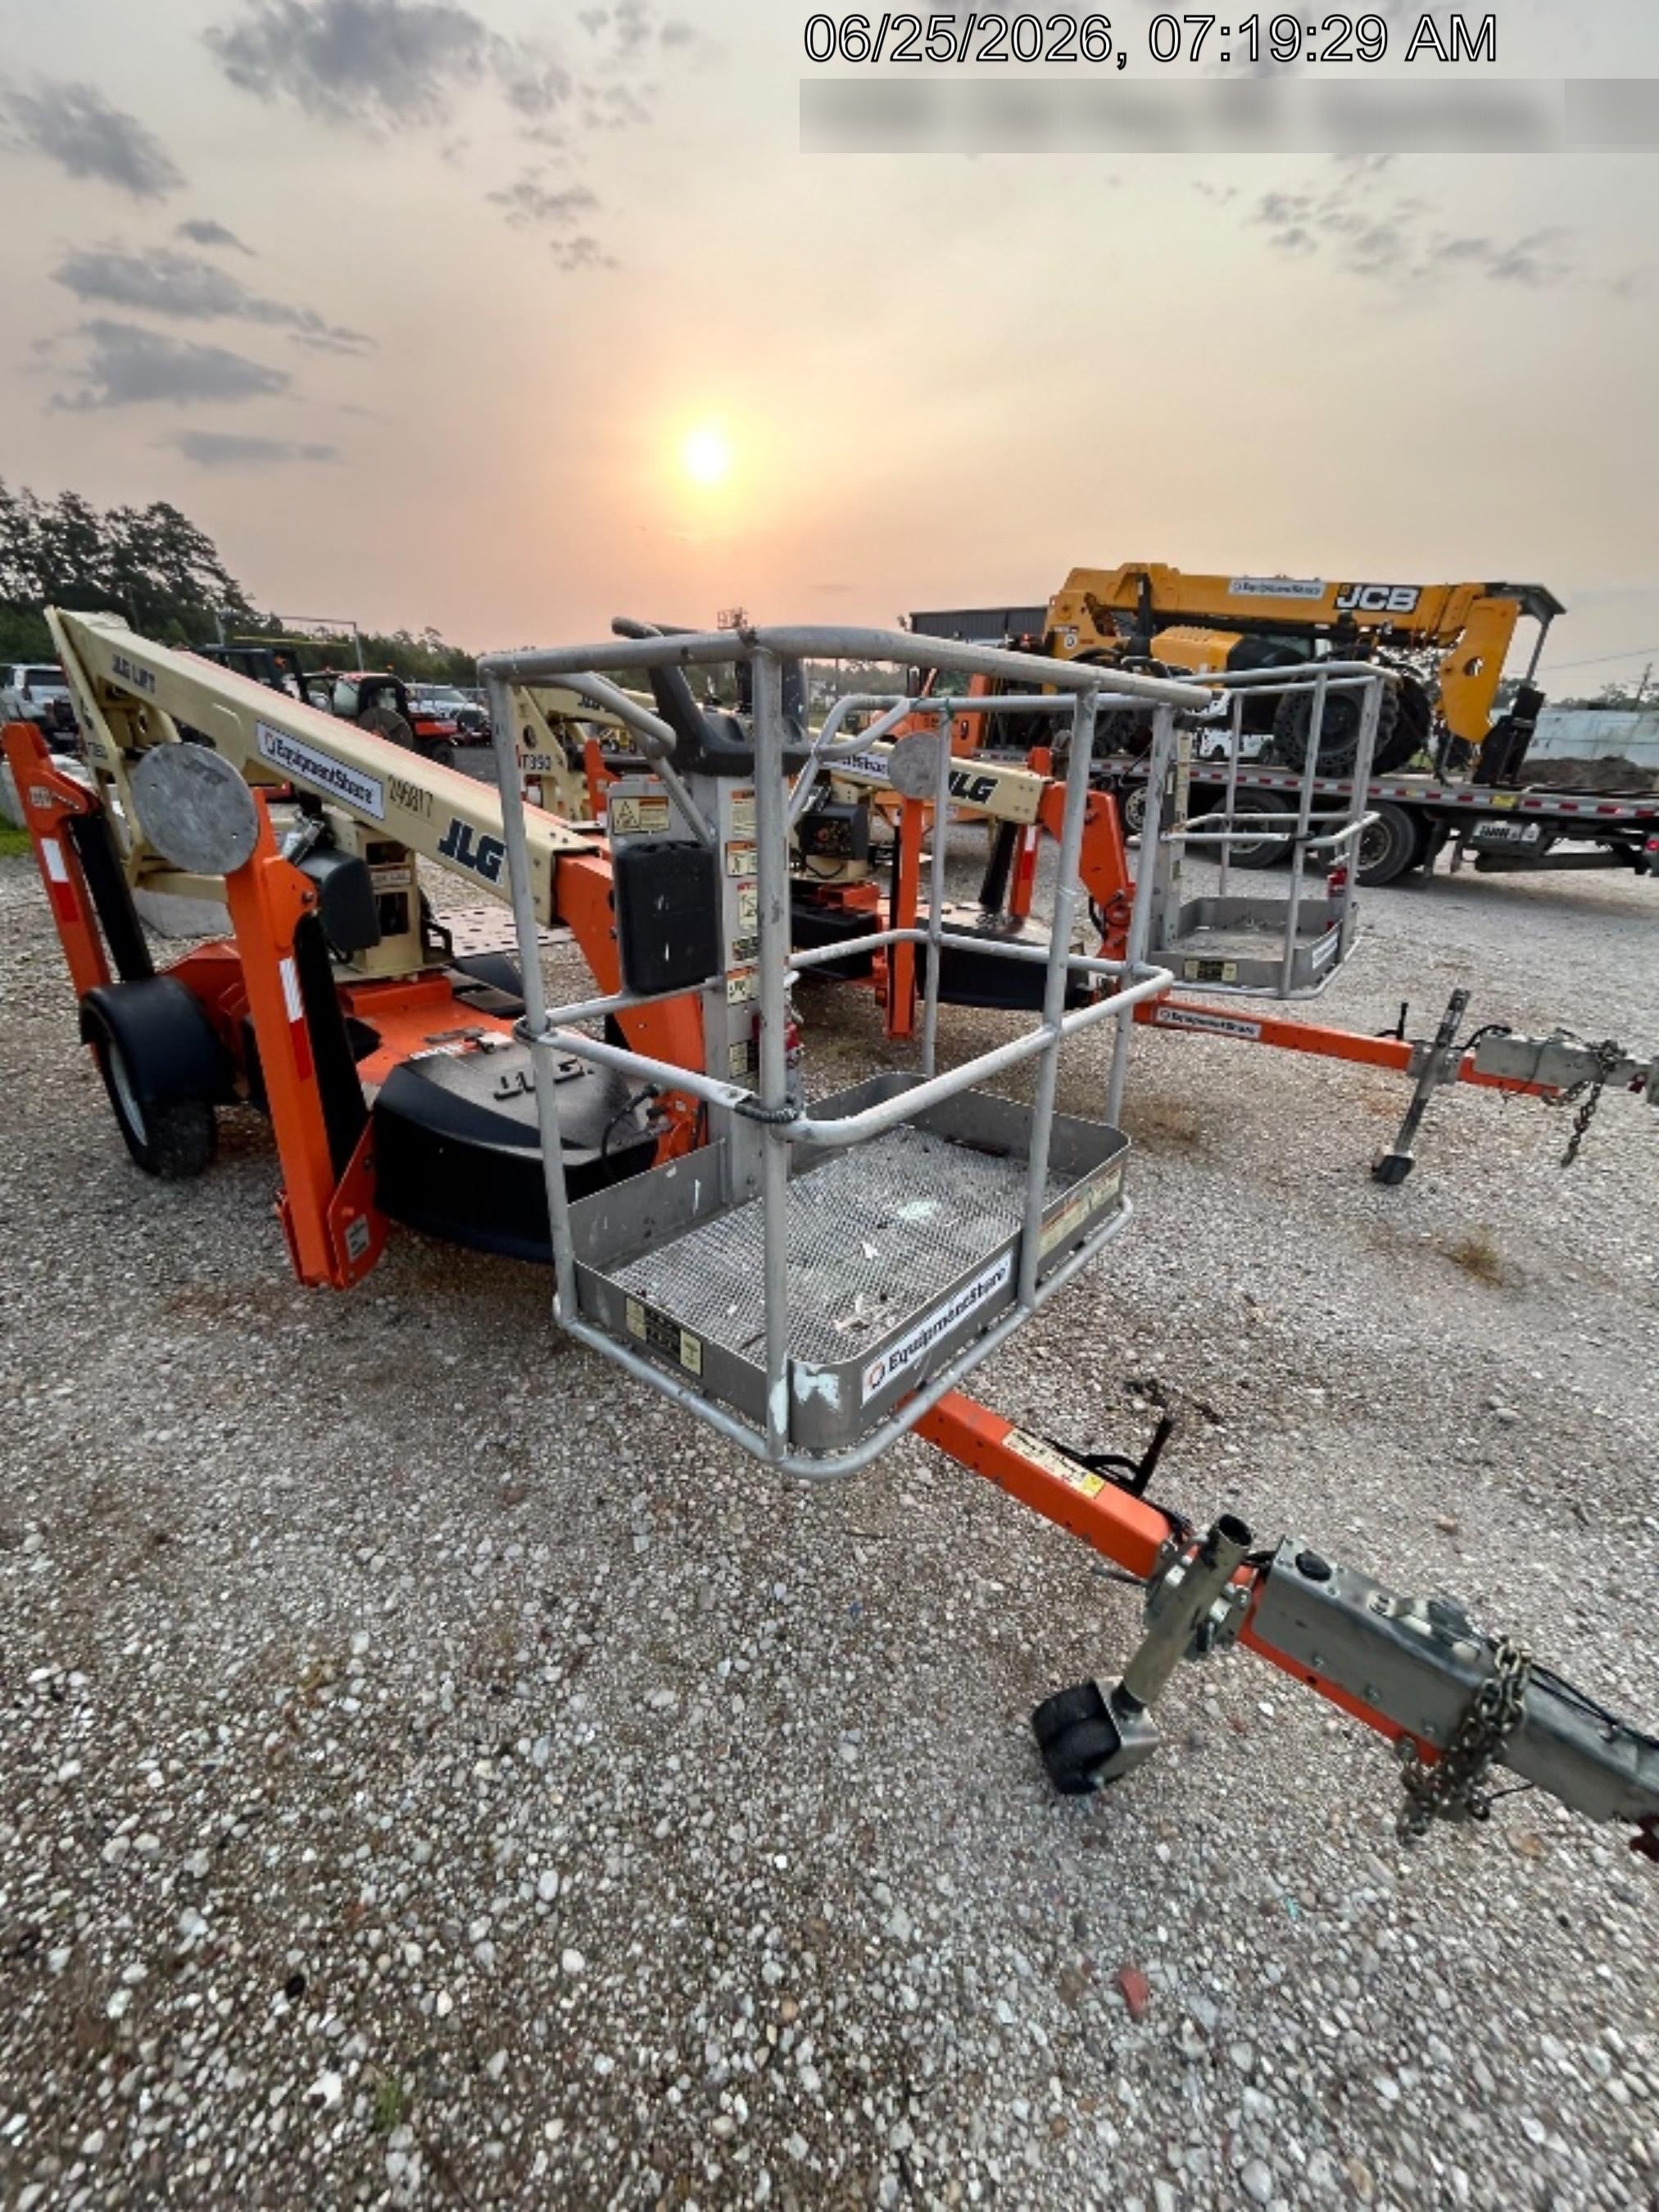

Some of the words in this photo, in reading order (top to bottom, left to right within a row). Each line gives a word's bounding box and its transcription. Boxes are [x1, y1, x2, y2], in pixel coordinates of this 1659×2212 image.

[1336, 584, 1420, 611] JCB
[437, 818, 507, 882] JLG
[888, 1267, 1008, 1373] EquipmentShare
